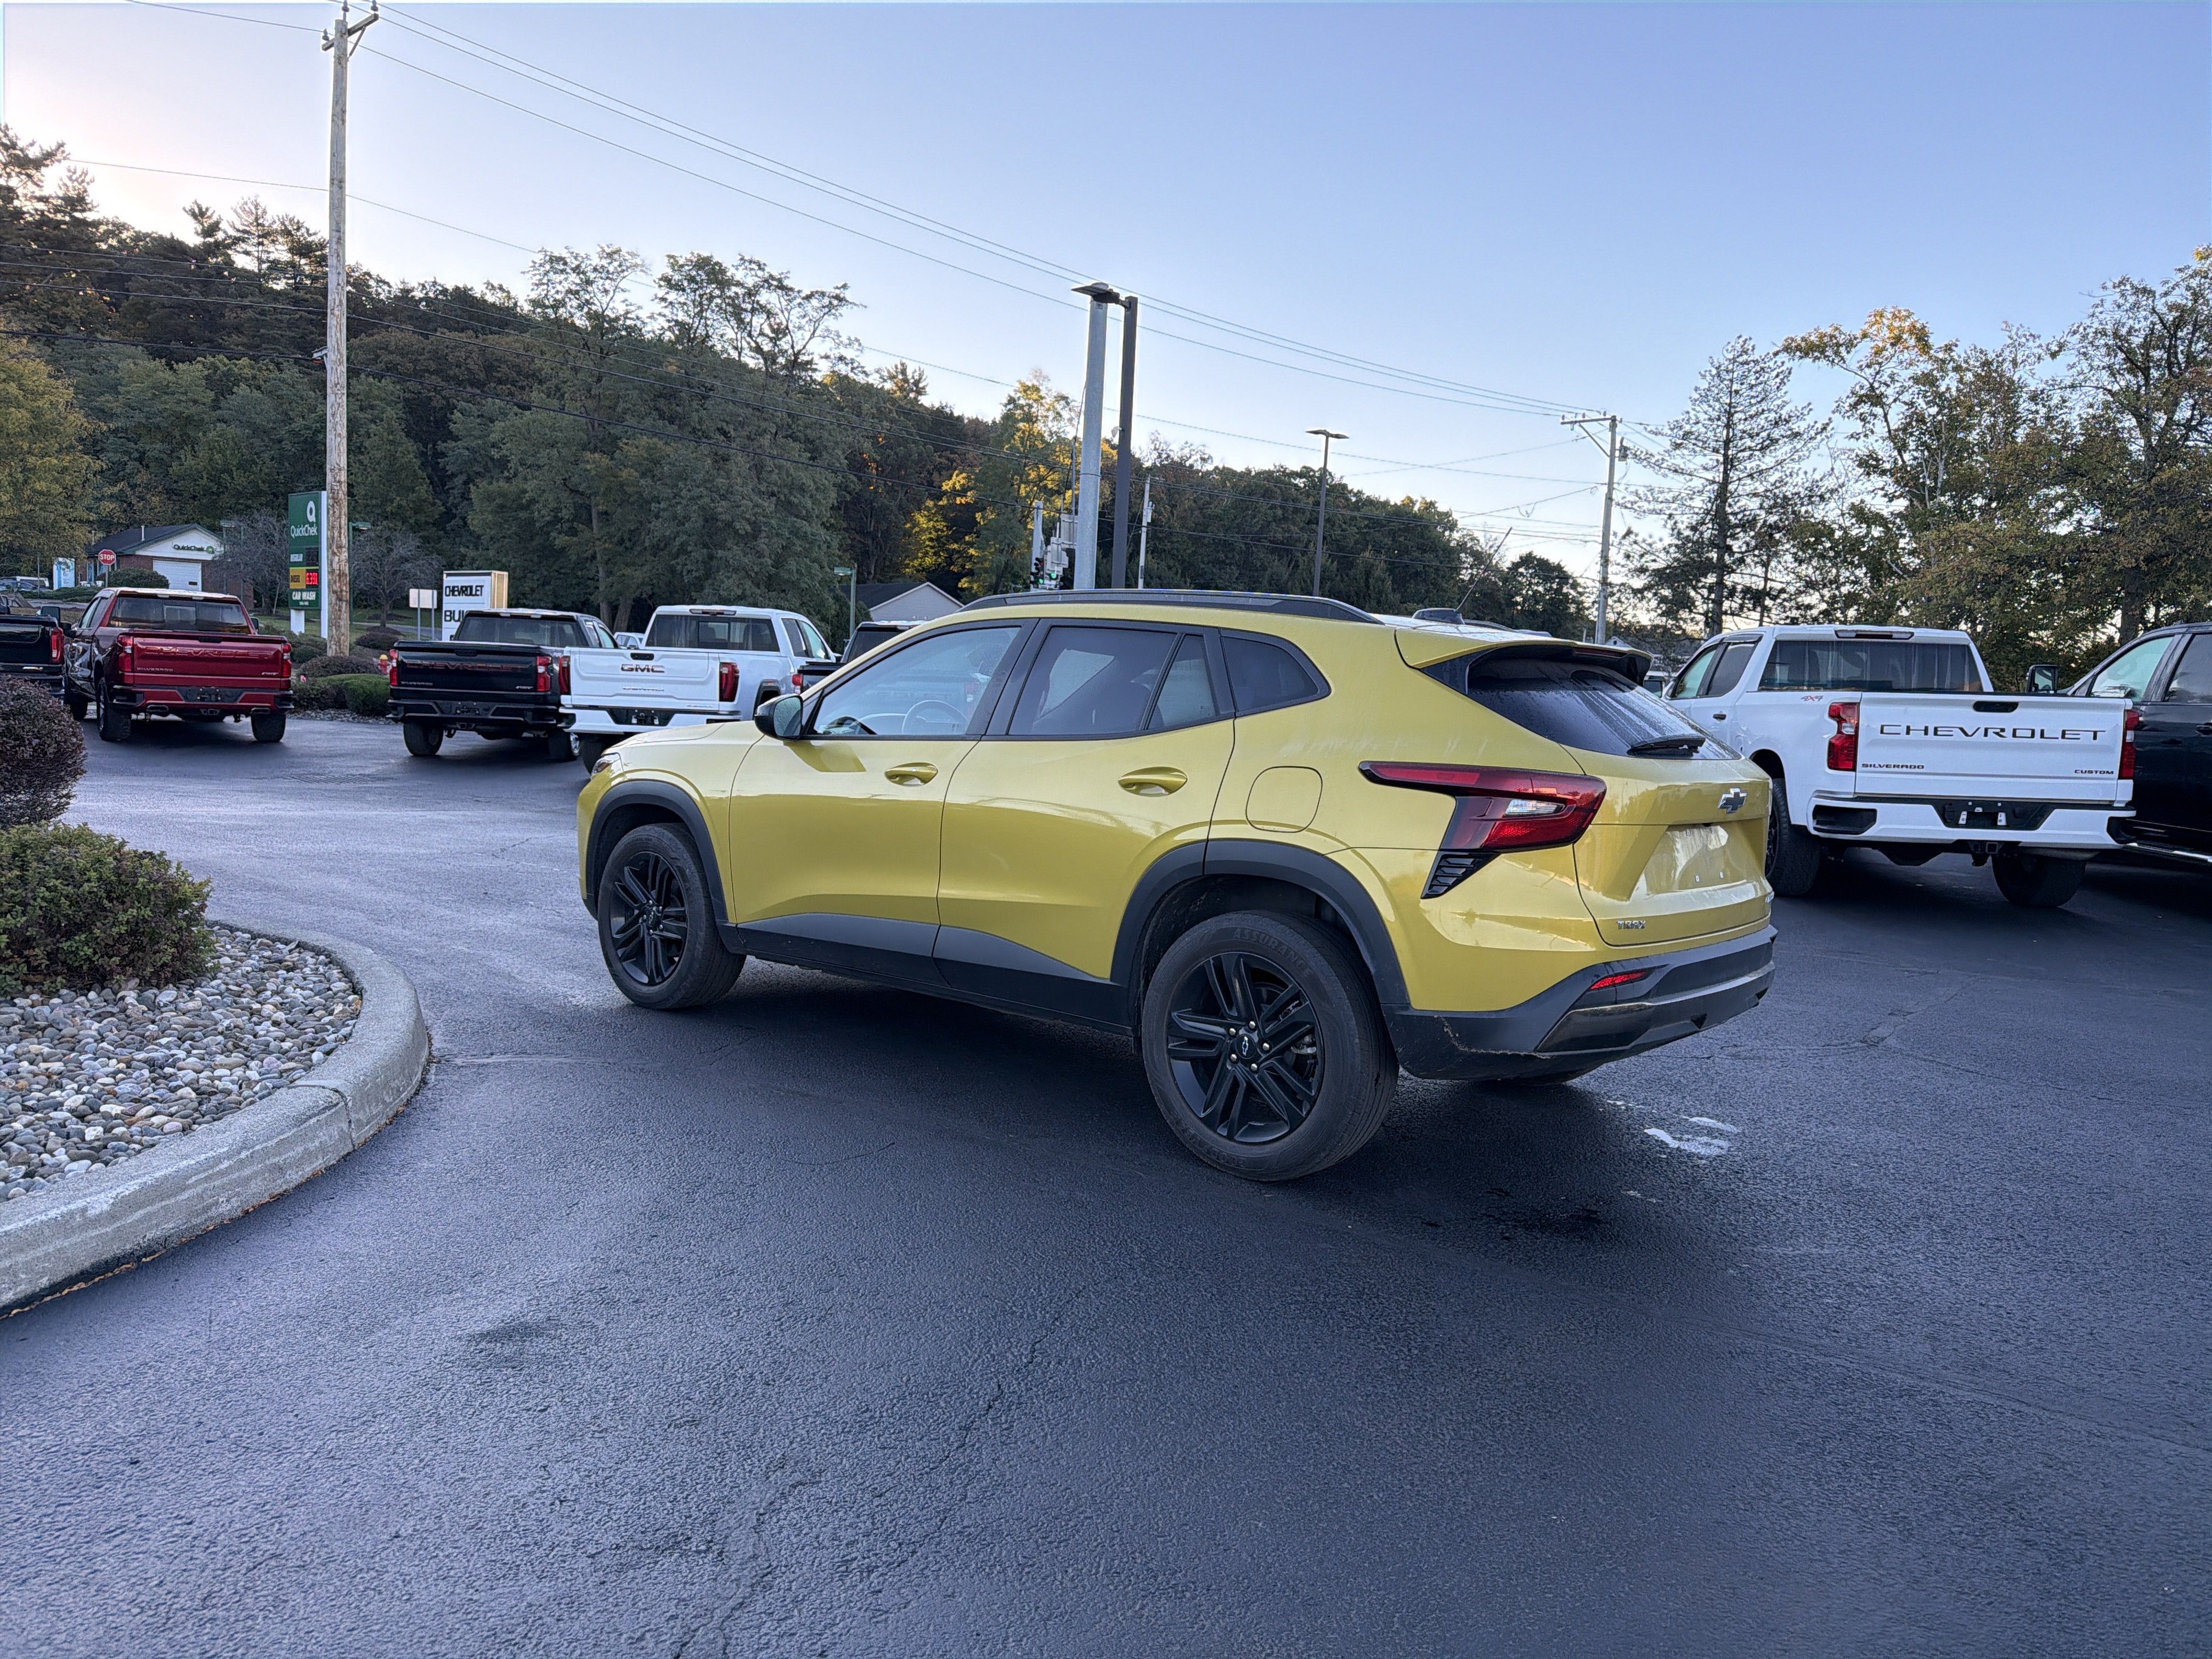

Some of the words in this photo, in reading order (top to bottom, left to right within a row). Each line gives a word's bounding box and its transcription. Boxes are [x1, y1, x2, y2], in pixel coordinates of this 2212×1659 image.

[290, 523, 318, 539] QuickChek
[292, 591, 301, 600] CAR
[302, 591, 316, 600] WASH
[445, 585, 484, 597] CHEVROLET
[620, 664, 665, 673] GMC
[1880, 724, 2107, 741] CHEVROLET
[1617, 920, 1646, 930] TRAX
